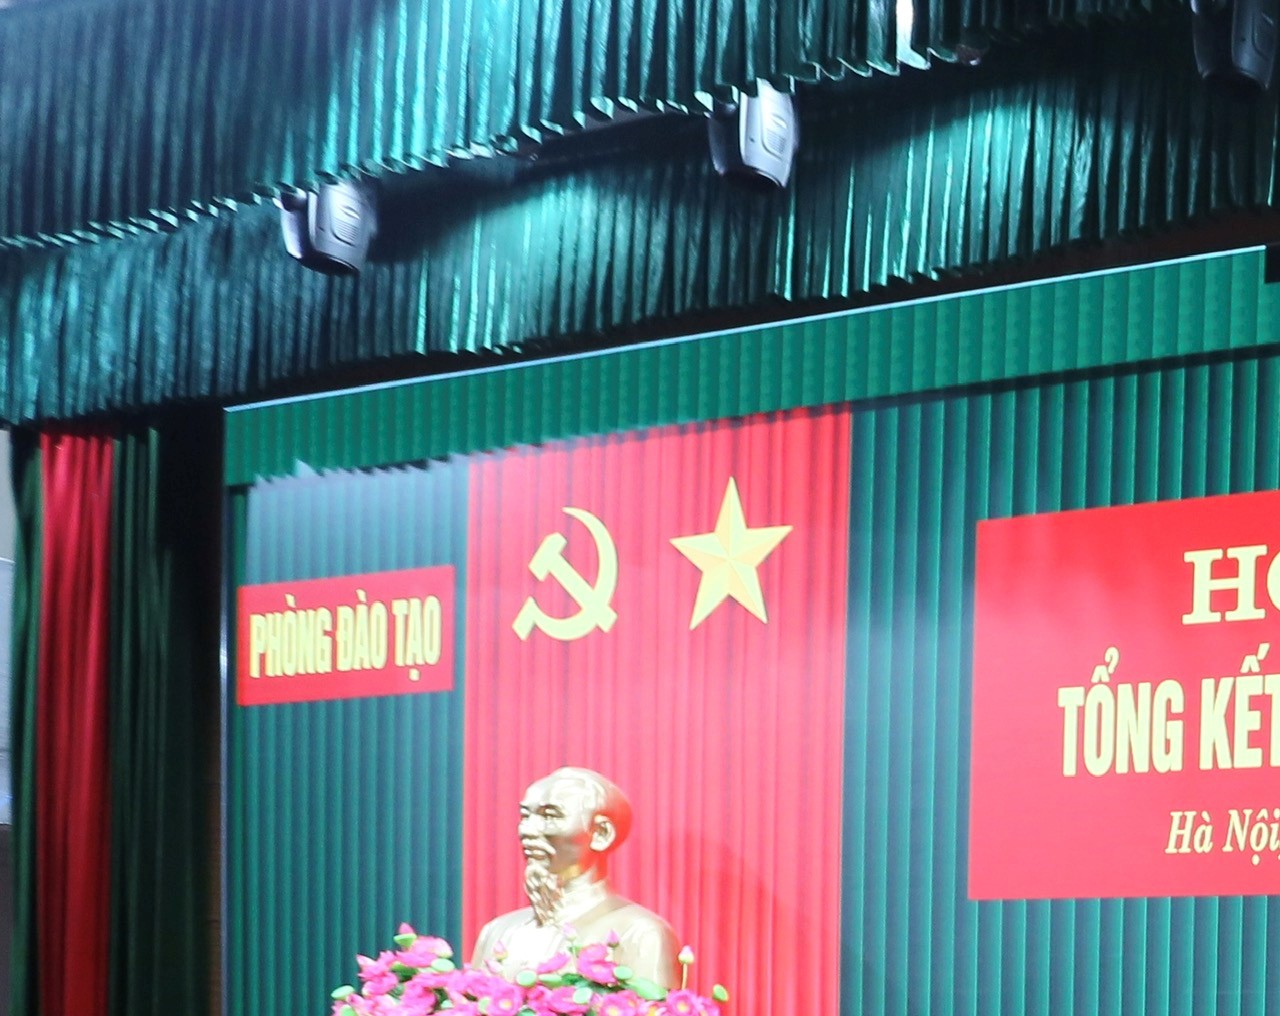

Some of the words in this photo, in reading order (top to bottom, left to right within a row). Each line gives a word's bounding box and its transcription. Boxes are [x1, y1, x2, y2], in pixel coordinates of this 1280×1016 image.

[249, 593, 333, 679] PHÒNG
[335, 588, 389, 672] ĐÀO
[391, 595, 443, 682] TẠO
[1056, 646, 1185, 778] TỔNG
[1164, 810, 1214, 855] Hà
